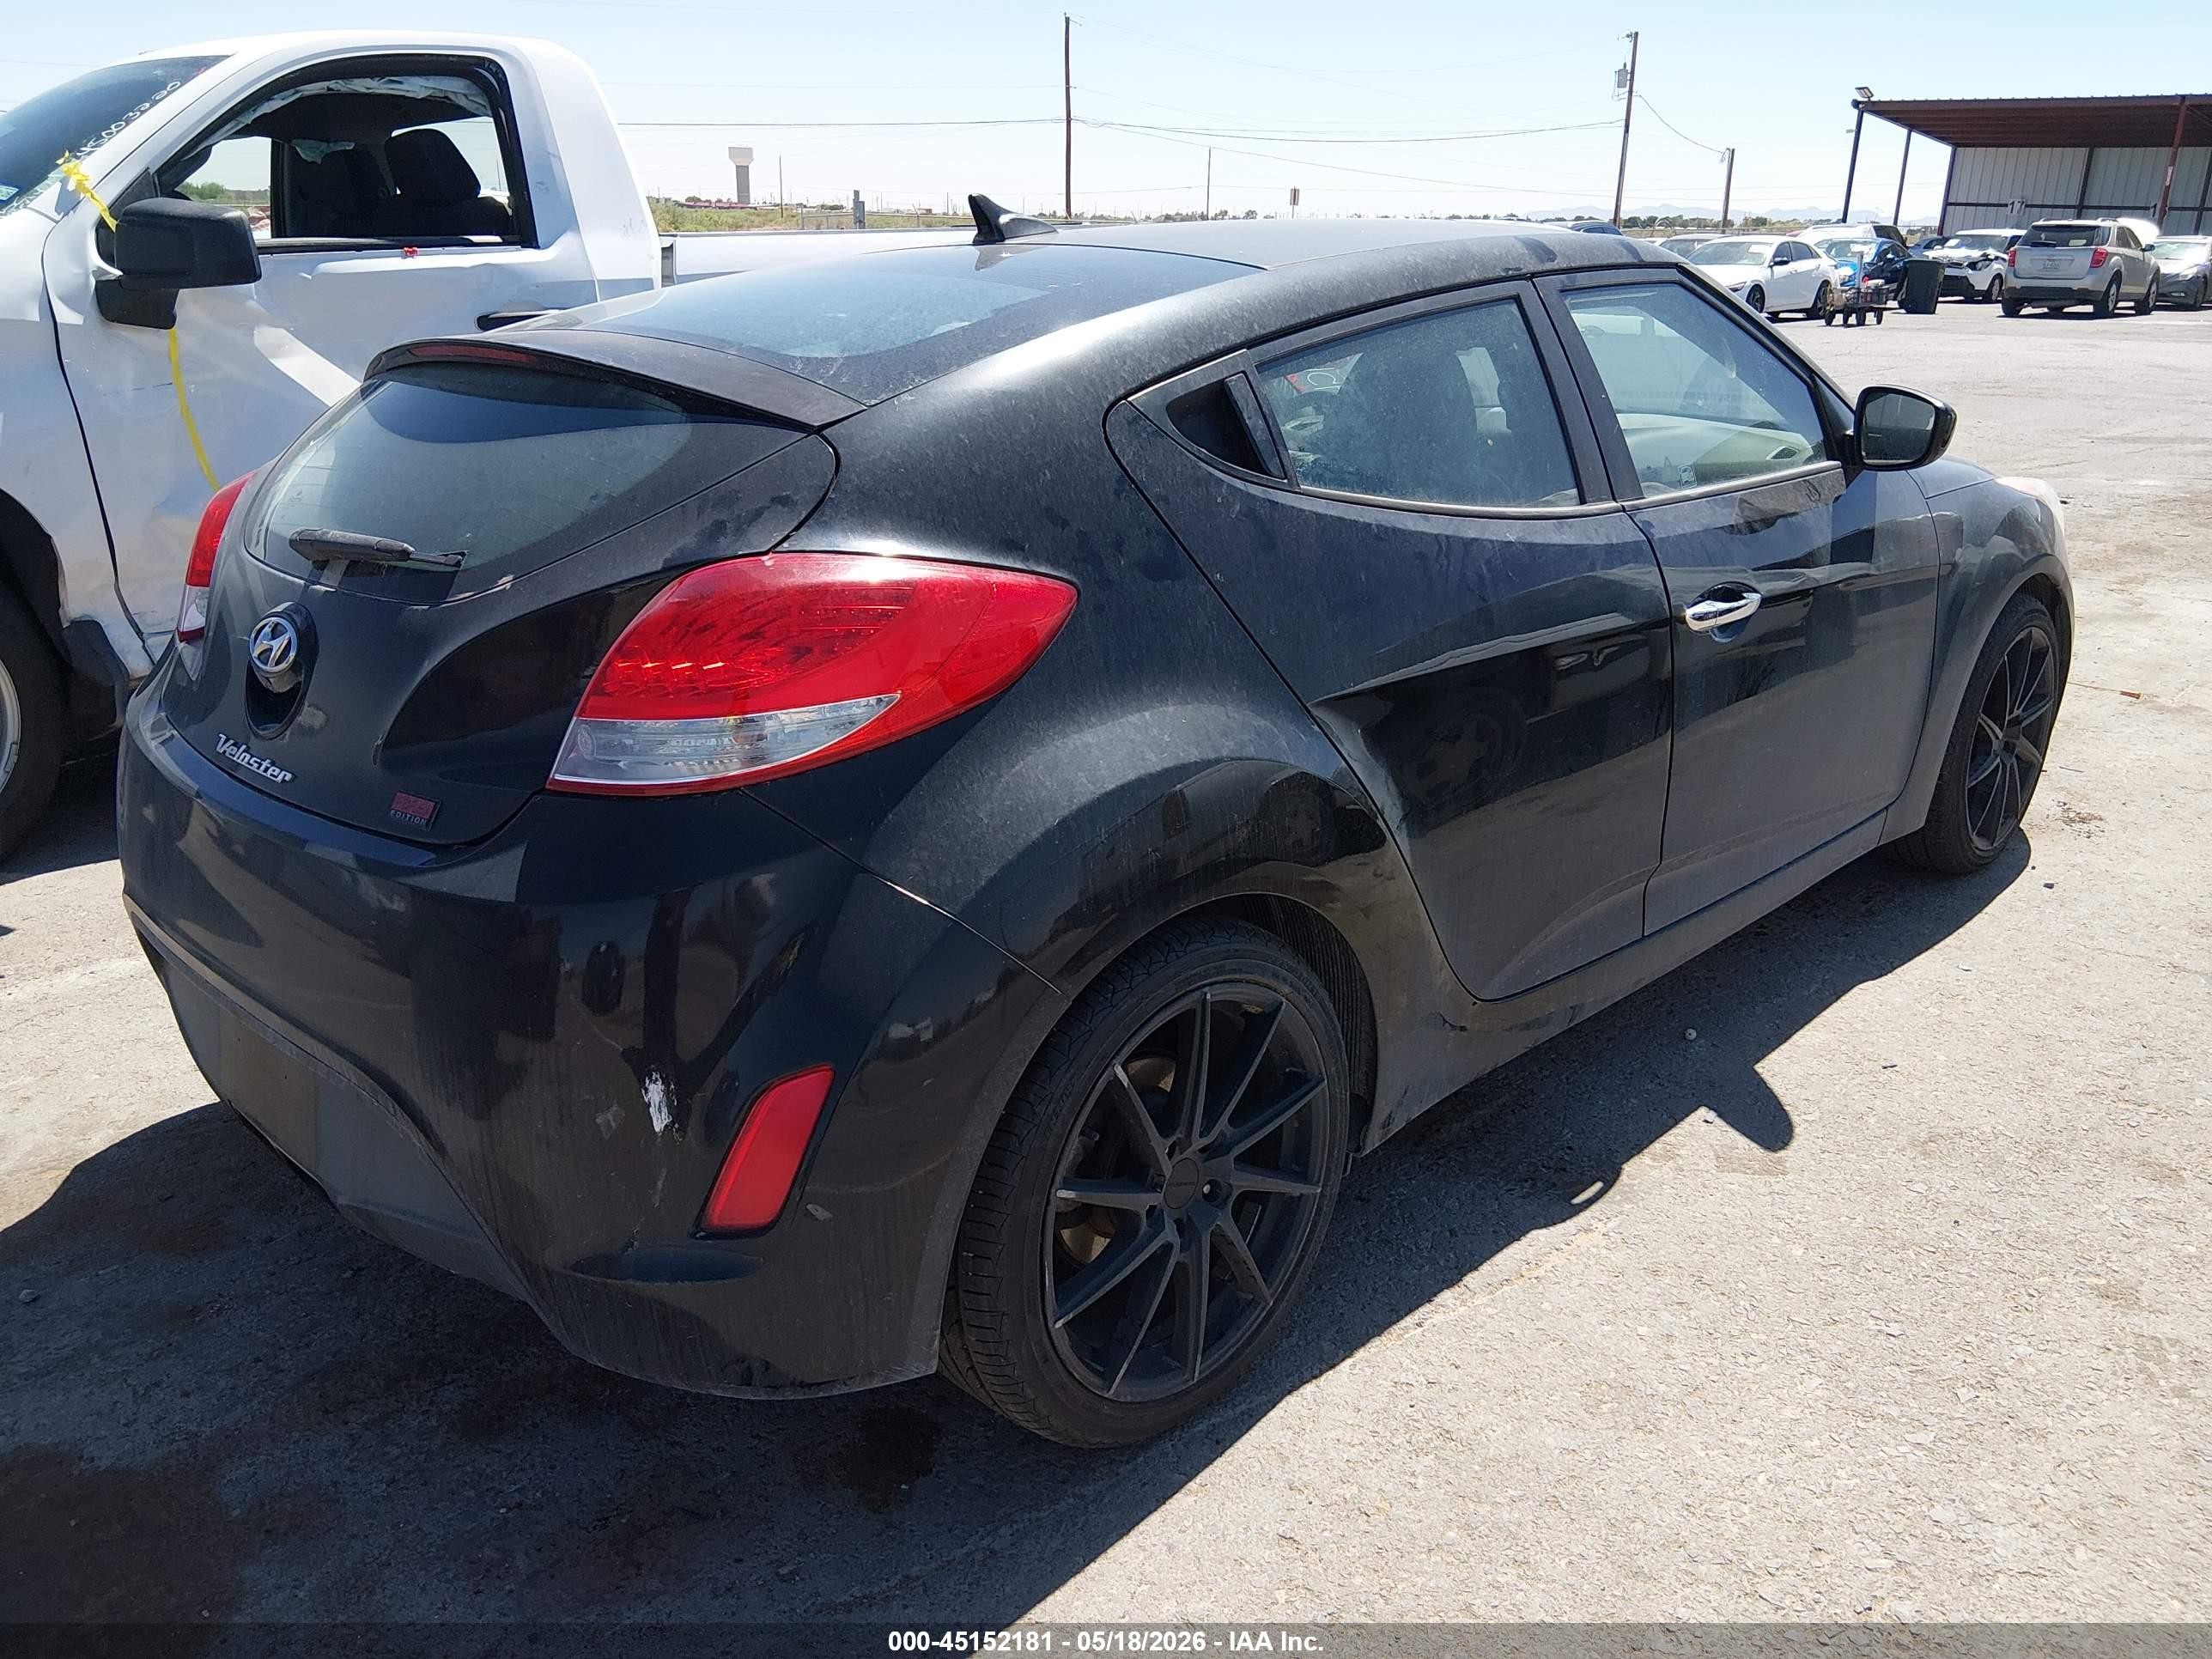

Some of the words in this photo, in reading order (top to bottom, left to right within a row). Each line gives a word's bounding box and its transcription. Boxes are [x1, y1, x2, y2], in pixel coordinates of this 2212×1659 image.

[2009, 200, 2025, 214] 17
[216, 733, 293, 783] Veloster
[390, 810, 428, 825] EDITION
